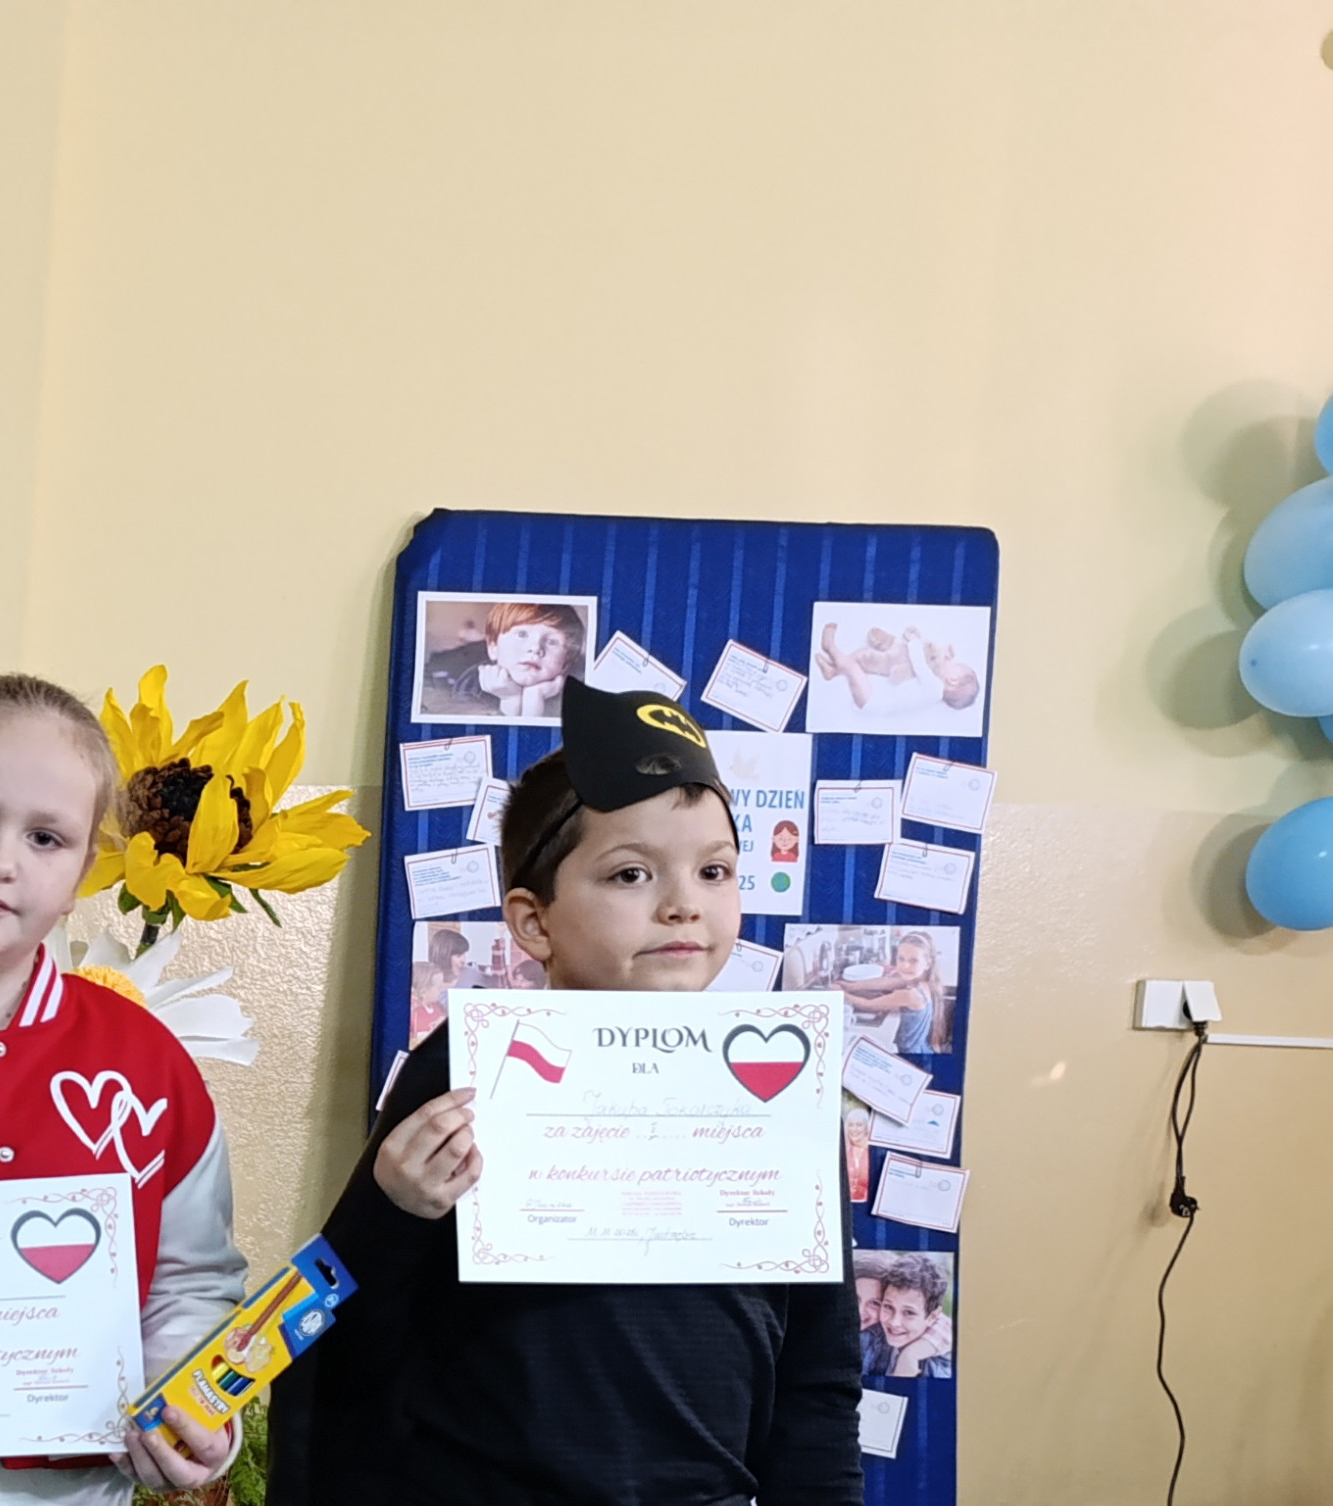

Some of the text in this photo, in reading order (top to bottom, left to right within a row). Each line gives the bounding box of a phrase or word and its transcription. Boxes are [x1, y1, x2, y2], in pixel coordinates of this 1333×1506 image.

[755, 788, 805, 809] DZIEŃ
[593, 1026, 713, 1053] DYPLOM
[632, 1062, 660, 1075] DLA
[543, 1125, 567, 1139] za
[571, 1122, 630, 1143] zajęcie
[692, 1122, 764, 1144] miejsca
[529, 1165, 781, 1188] w konkursie patriotycznym
[527, 1215, 577, 1226] Organizator
[728, 1217, 769, 1228] Dyrektor
[26, 1393, 69, 1405] Dyrektor
[193, 1370, 229, 1413] FLAMASTRY
